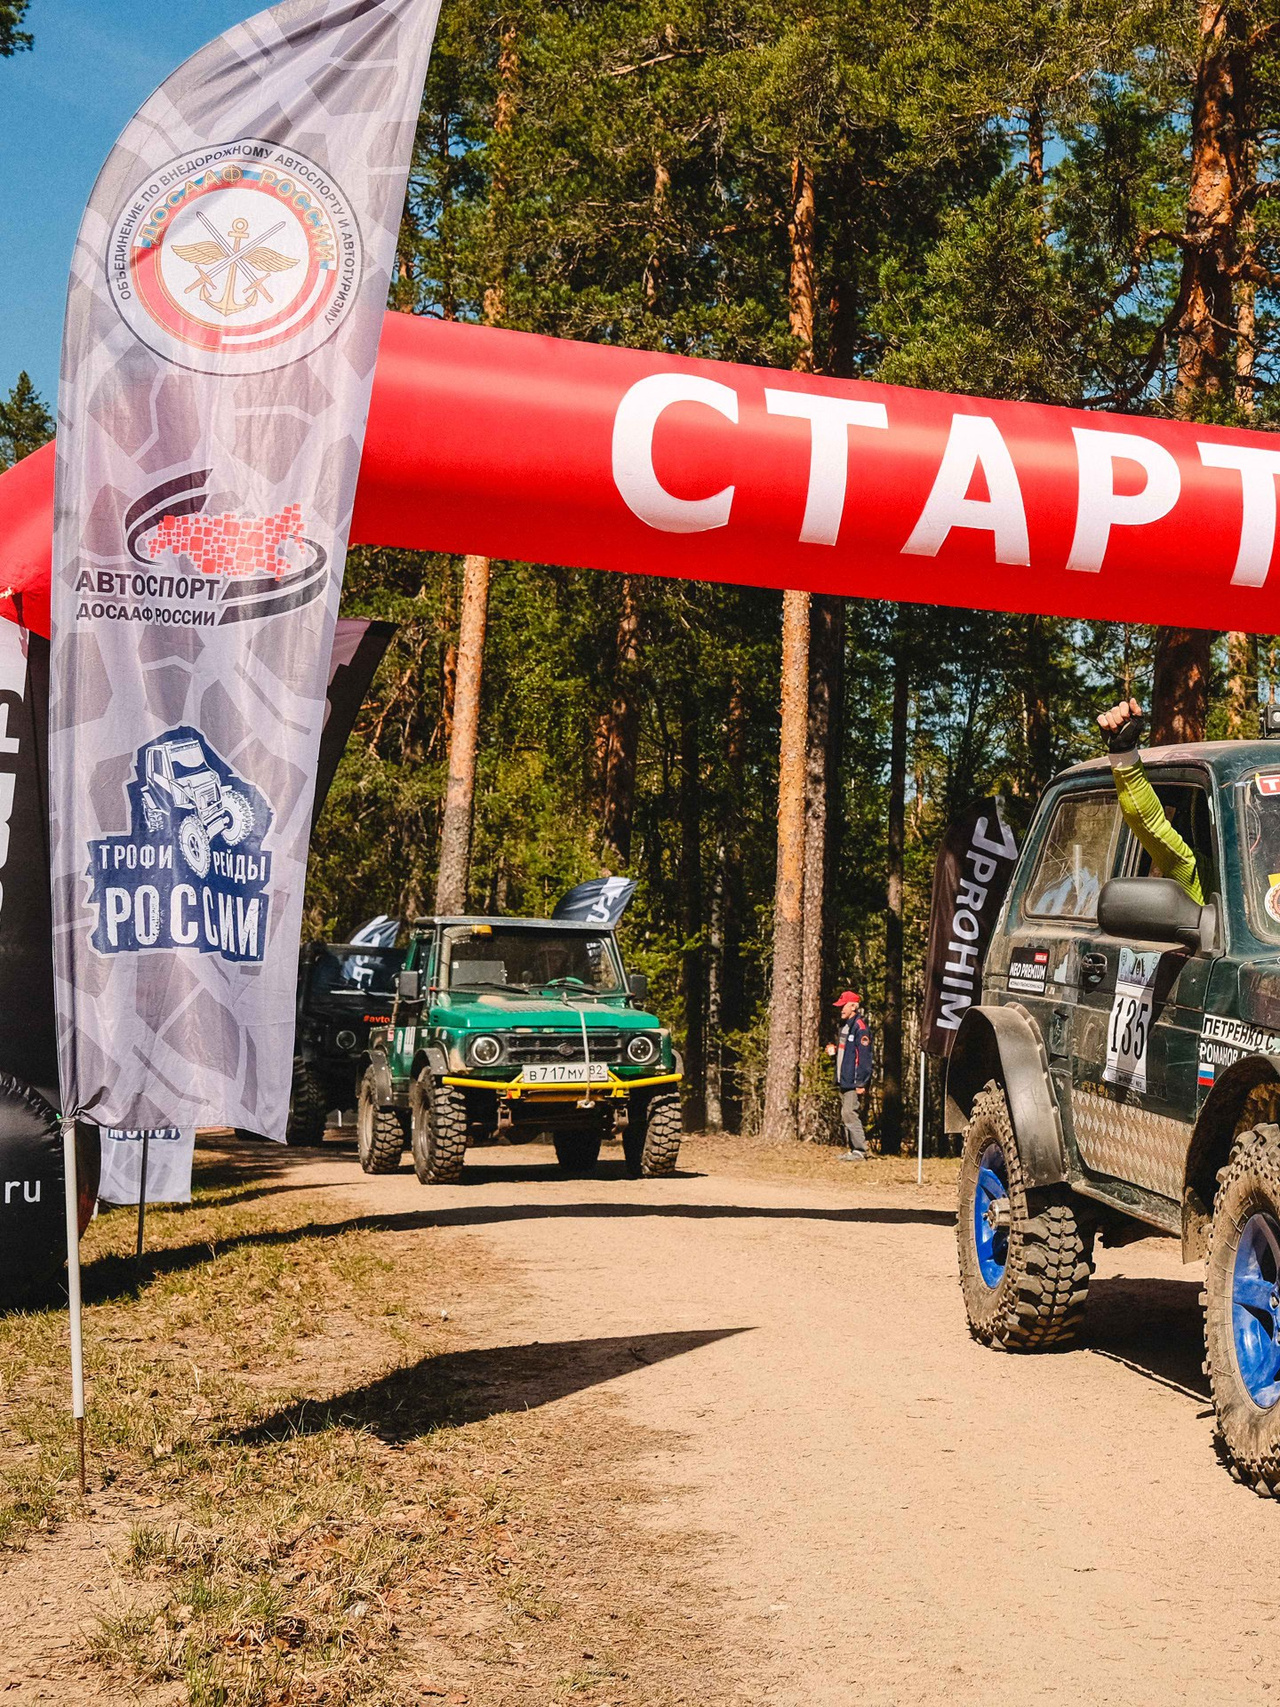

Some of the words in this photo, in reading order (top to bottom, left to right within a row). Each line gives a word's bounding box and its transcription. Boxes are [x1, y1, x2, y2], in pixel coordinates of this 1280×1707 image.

[160, 145, 274, 187] ВНЕДОРОЖНОМУ
[274, 154, 345, 216] АВТОСПОРТУ
[139, 164, 243, 245] ДОСААФ
[259, 169, 335, 262] РОССИИ
[141, 184, 160, 203] ПО
[338, 218, 350, 229] И
[114, 204, 145, 300] ОБЪЕДИНЕНИЕ
[324, 232, 355, 325] АВТОТУРИЗМУ
[75, 570, 220, 601] АВТОСПОРТ
[76, 602, 153, 622] ДОСААФ
[154, 607, 215, 627] РОССИИ
[99, 844, 173, 870] ТРОФИ
[213, 849, 266, 885] РЕЙДЫ
[105, 883, 260, 957] РОССИИ
[1110, 997, 1149, 1061] 135
[1202, 1017, 1264, 1048] ПЕТРЕНКО
